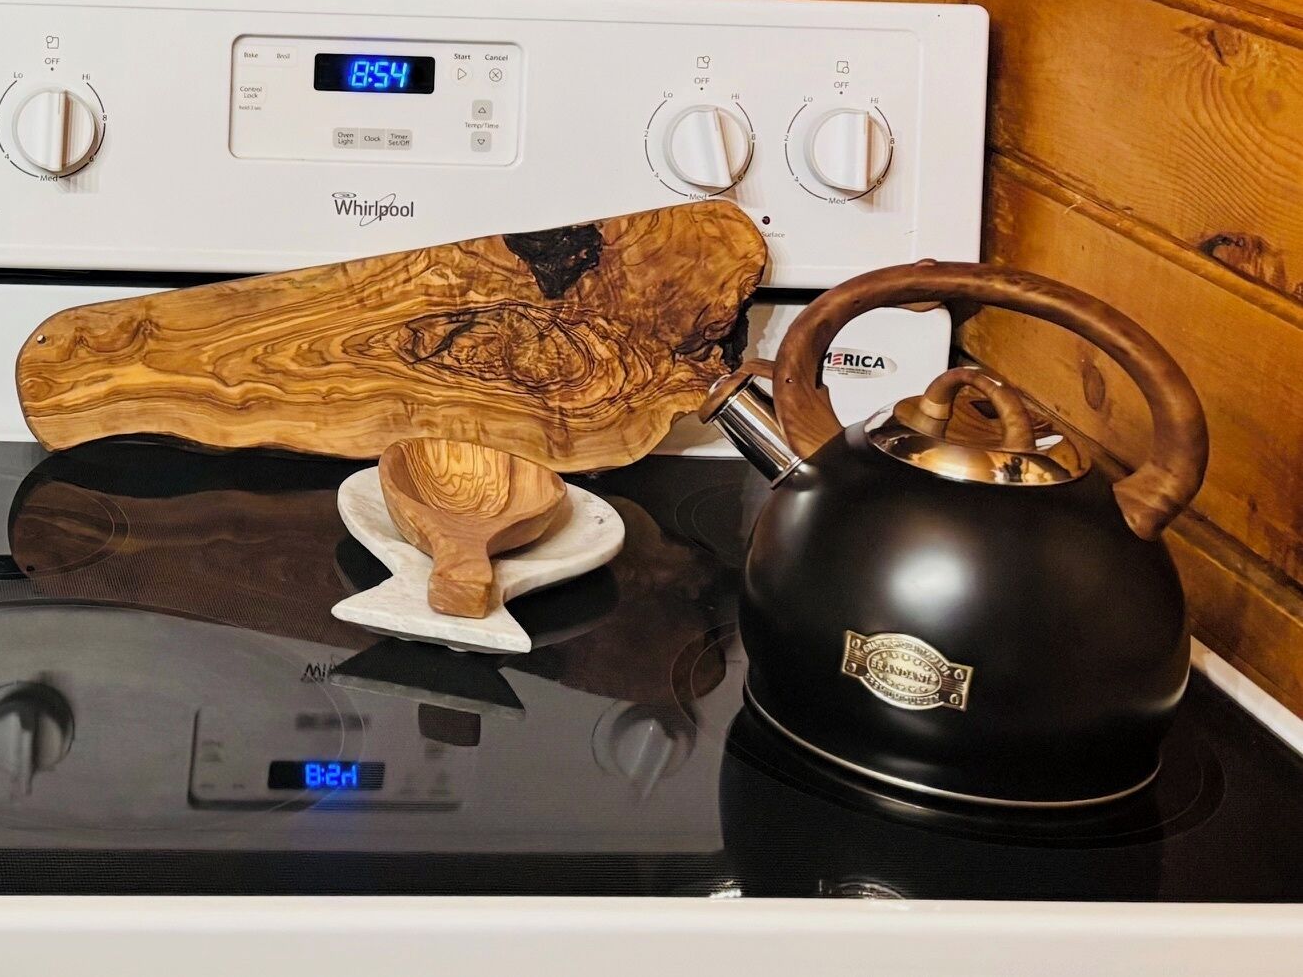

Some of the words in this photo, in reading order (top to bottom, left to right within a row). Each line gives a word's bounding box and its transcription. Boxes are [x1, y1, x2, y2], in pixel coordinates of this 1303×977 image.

[44, 57, 60, 65] OFF
[82, 73, 91, 81] Hi
[351, 61, 408, 88] 8:54
[694, 77, 710, 85] OFF
[833, 81, 850, 89] OFF
[803, 95, 814, 103] Lo
[870, 96, 879, 104] Hi
[465, 122, 499, 130] Temp/Time
[40, 174, 58, 182] Med
[689, 193, 707, 201] Med
[828, 197, 846, 205] Med
[334, 199, 414, 221] Whirlpool
